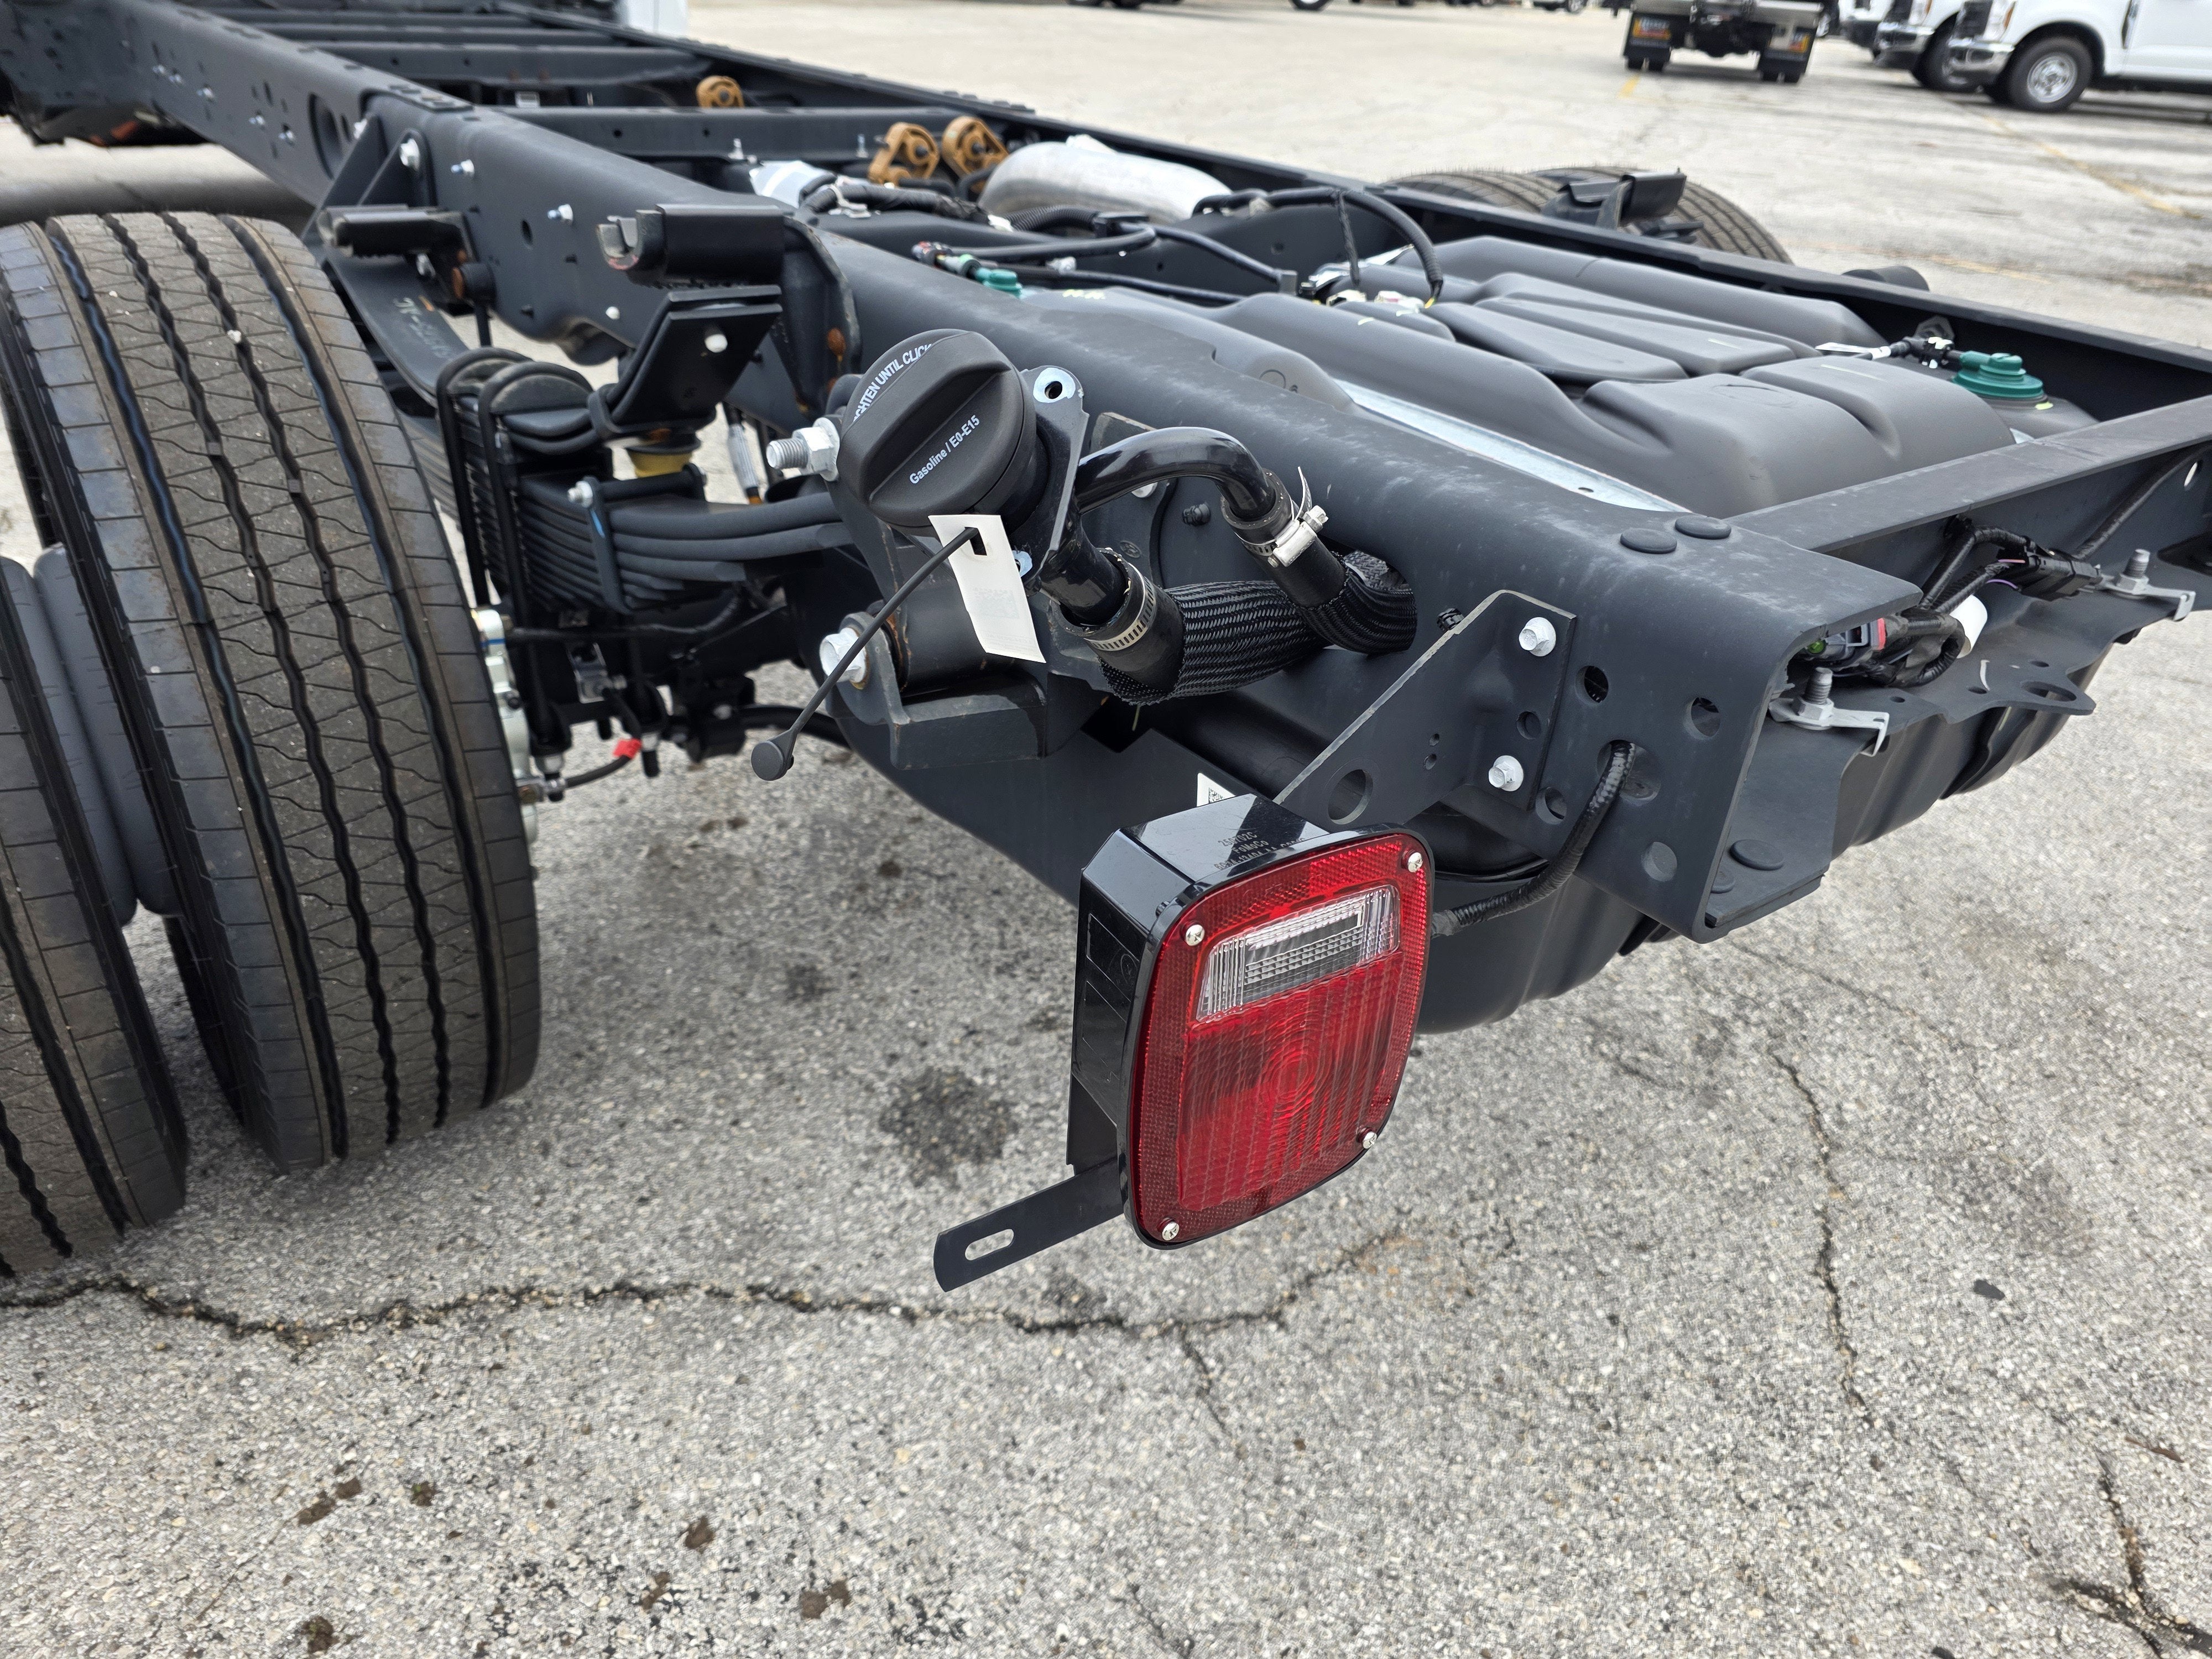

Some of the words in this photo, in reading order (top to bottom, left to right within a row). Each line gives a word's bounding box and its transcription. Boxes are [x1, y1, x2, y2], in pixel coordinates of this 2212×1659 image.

[875, 359, 904, 385] UNTIL
[948, 415, 980, 448] E0-E15
[945, 442, 952, 453] /
[909, 449, 948, 484] Gasoline
[1231, 840, 1269, 854] FoMoCo
